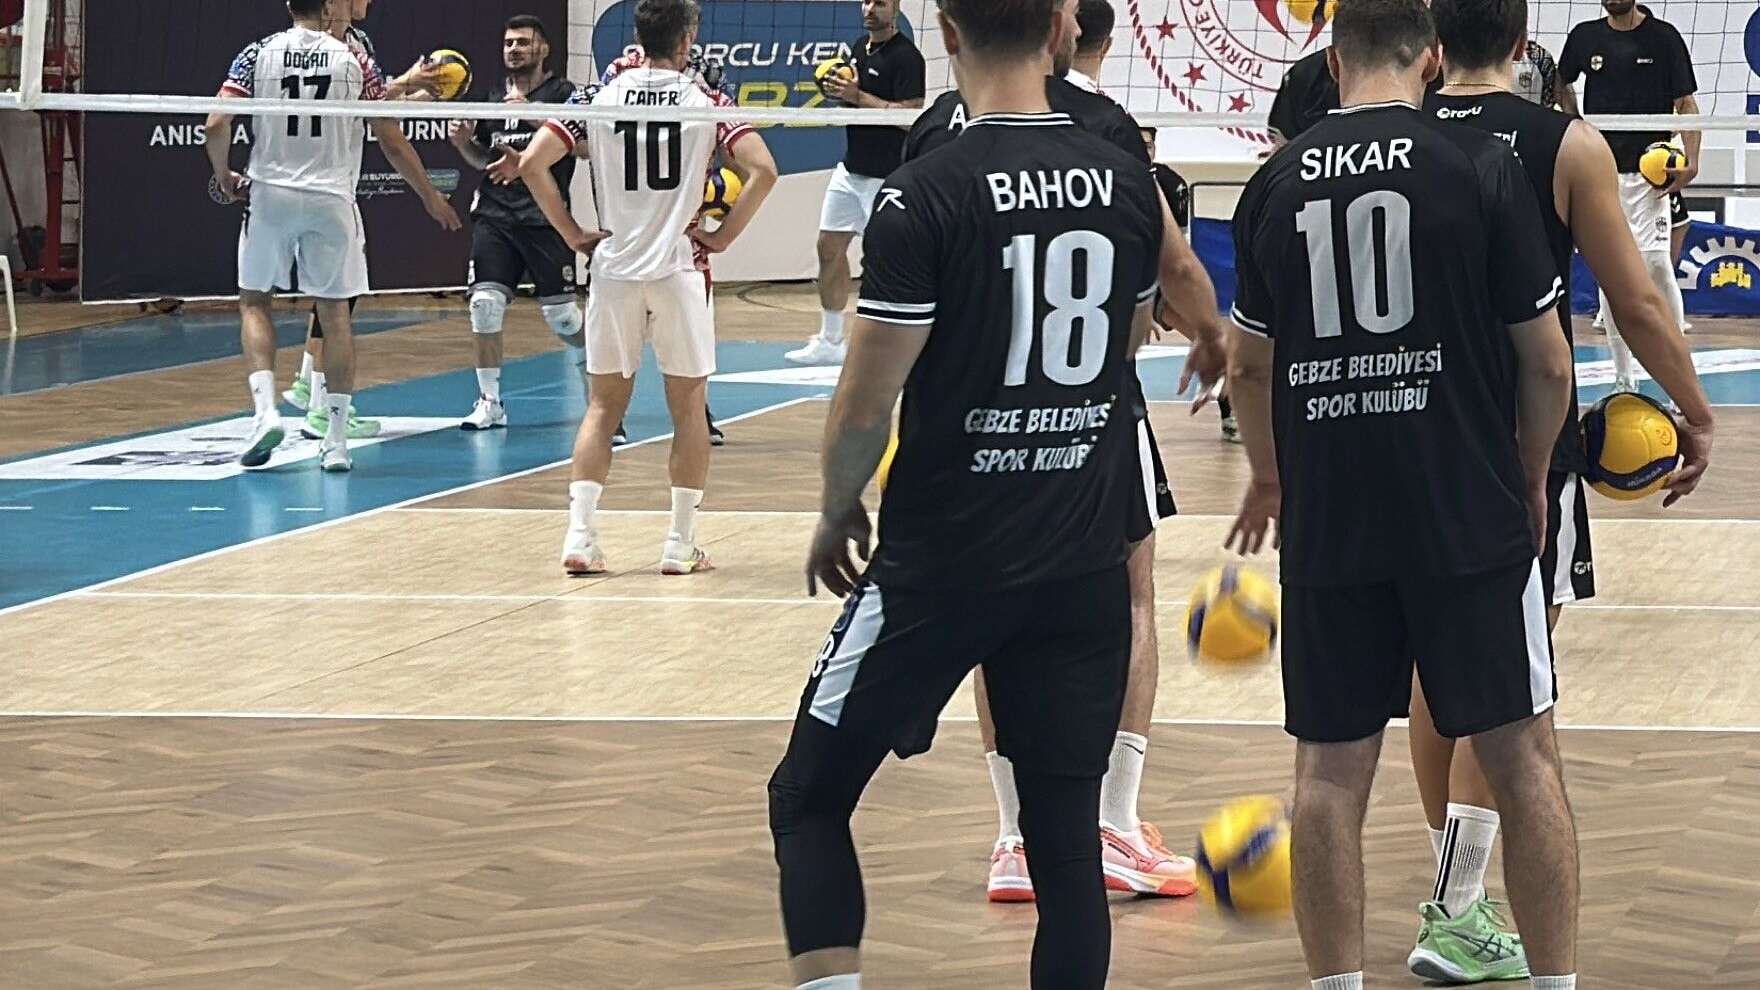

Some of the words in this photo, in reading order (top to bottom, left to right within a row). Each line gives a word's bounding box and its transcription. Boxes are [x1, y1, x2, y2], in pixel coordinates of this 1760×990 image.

[1195, 13, 1264, 79] TÜRKİYE
[281, 74, 332, 138] 17
[614, 120, 682, 192] 10
[1300, 137, 1413, 182] SIKAR
[985, 168, 1114, 213] BAHOV
[1296, 189, 1415, 339] 10
[1002, 229, 1115, 387] 18
[1288, 356, 1343, 387] GEBZE
[1347, 342, 1442, 380] BELEDİYESİ
[1306, 393, 1357, 422] SPOR
[1361, 379, 1430, 414] KULÜBÜ
[970, 448, 1028, 473] SPOR
